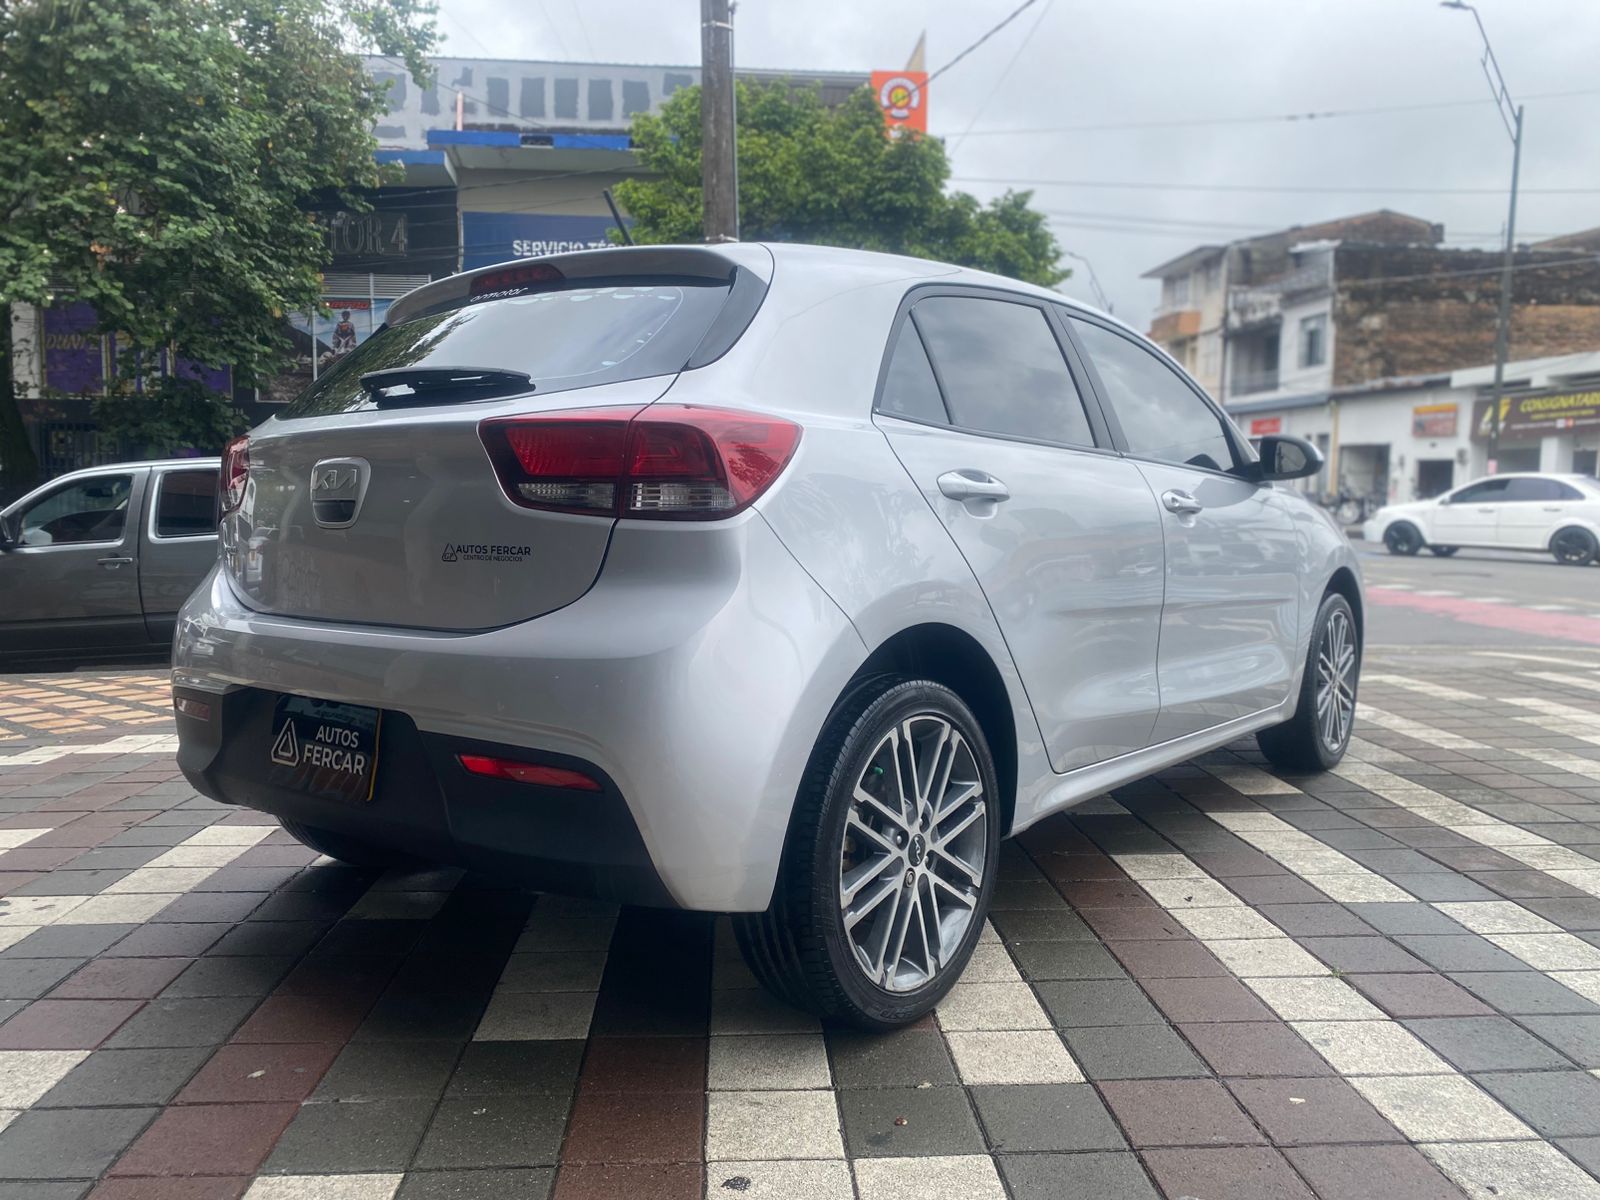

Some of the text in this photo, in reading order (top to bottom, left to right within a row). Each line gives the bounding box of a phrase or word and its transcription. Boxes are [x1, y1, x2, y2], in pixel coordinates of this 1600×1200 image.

[512, 240, 584, 257] SERVICIO
[456, 544, 531, 556] AUTOS FERCAR
[315, 725, 359, 748] AUTOS
[303, 743, 365, 775] FERCAR
